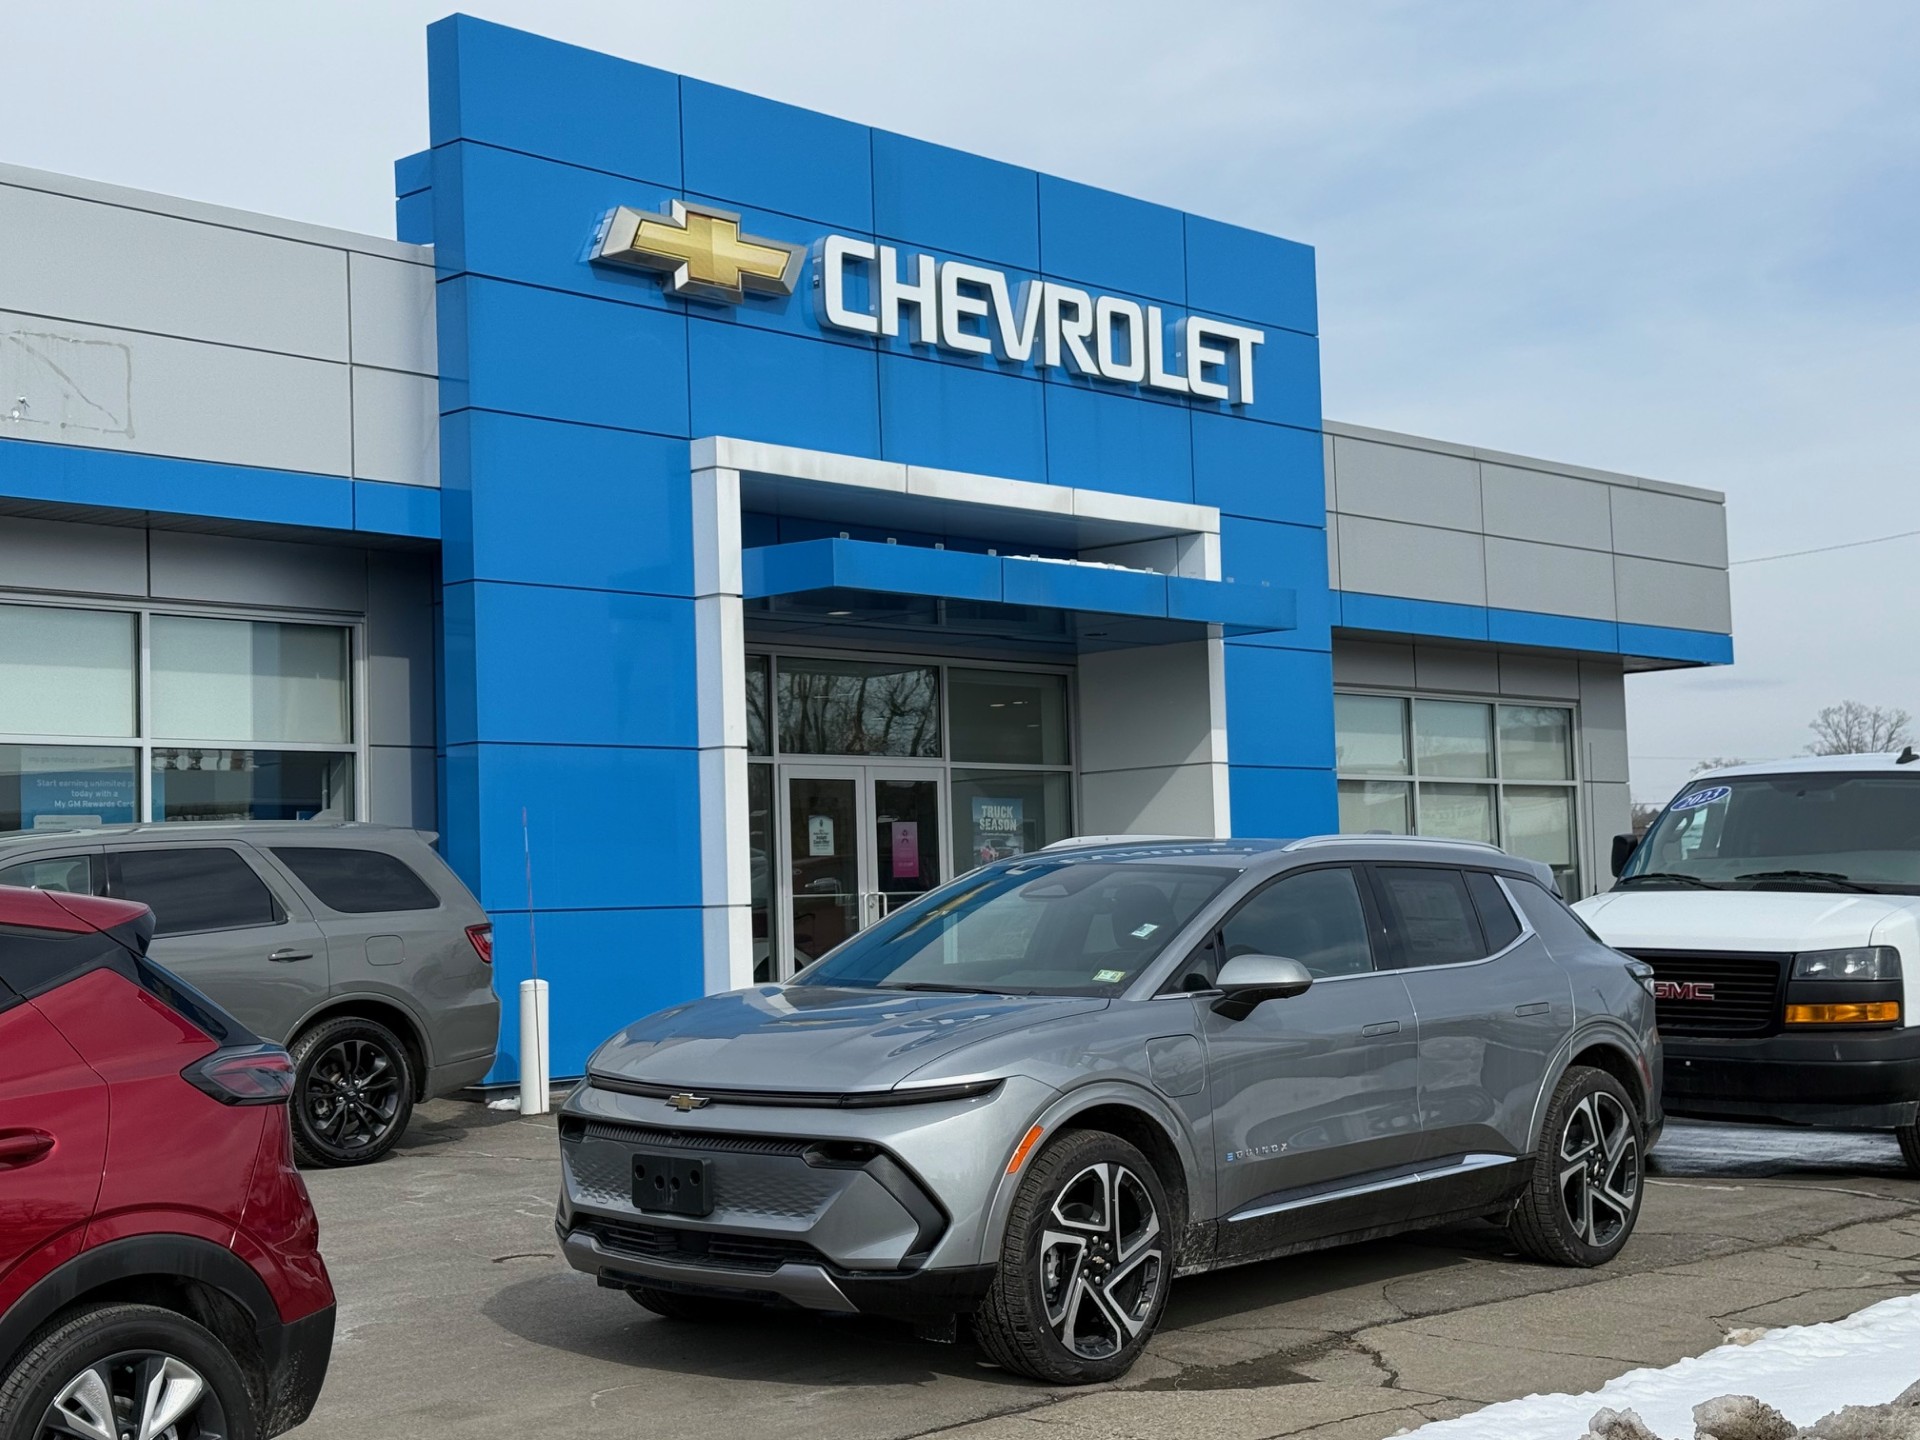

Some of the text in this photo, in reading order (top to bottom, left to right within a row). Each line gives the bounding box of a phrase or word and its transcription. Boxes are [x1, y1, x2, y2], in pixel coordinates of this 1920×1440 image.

[822, 234, 1265, 405] CHEVROLET
[36, 779, 57, 787] Start
[59, 780, 89, 789] earning
[89, 780, 127, 788] unlimited
[71, 790, 93, 799] today
[95, 790, 112, 798] with
[1679, 788, 1723, 808] 2023
[54, 800, 66, 809] My
[67, 800, 81, 808] GM
[82, 800, 116, 808] Rewards
[981, 805, 1014, 819] TRUCK
[979, 818, 1017, 831] SEASON
[1654, 981, 1715, 1001] GMC
[1226, 1142, 1288, 1162] EQUINOX
